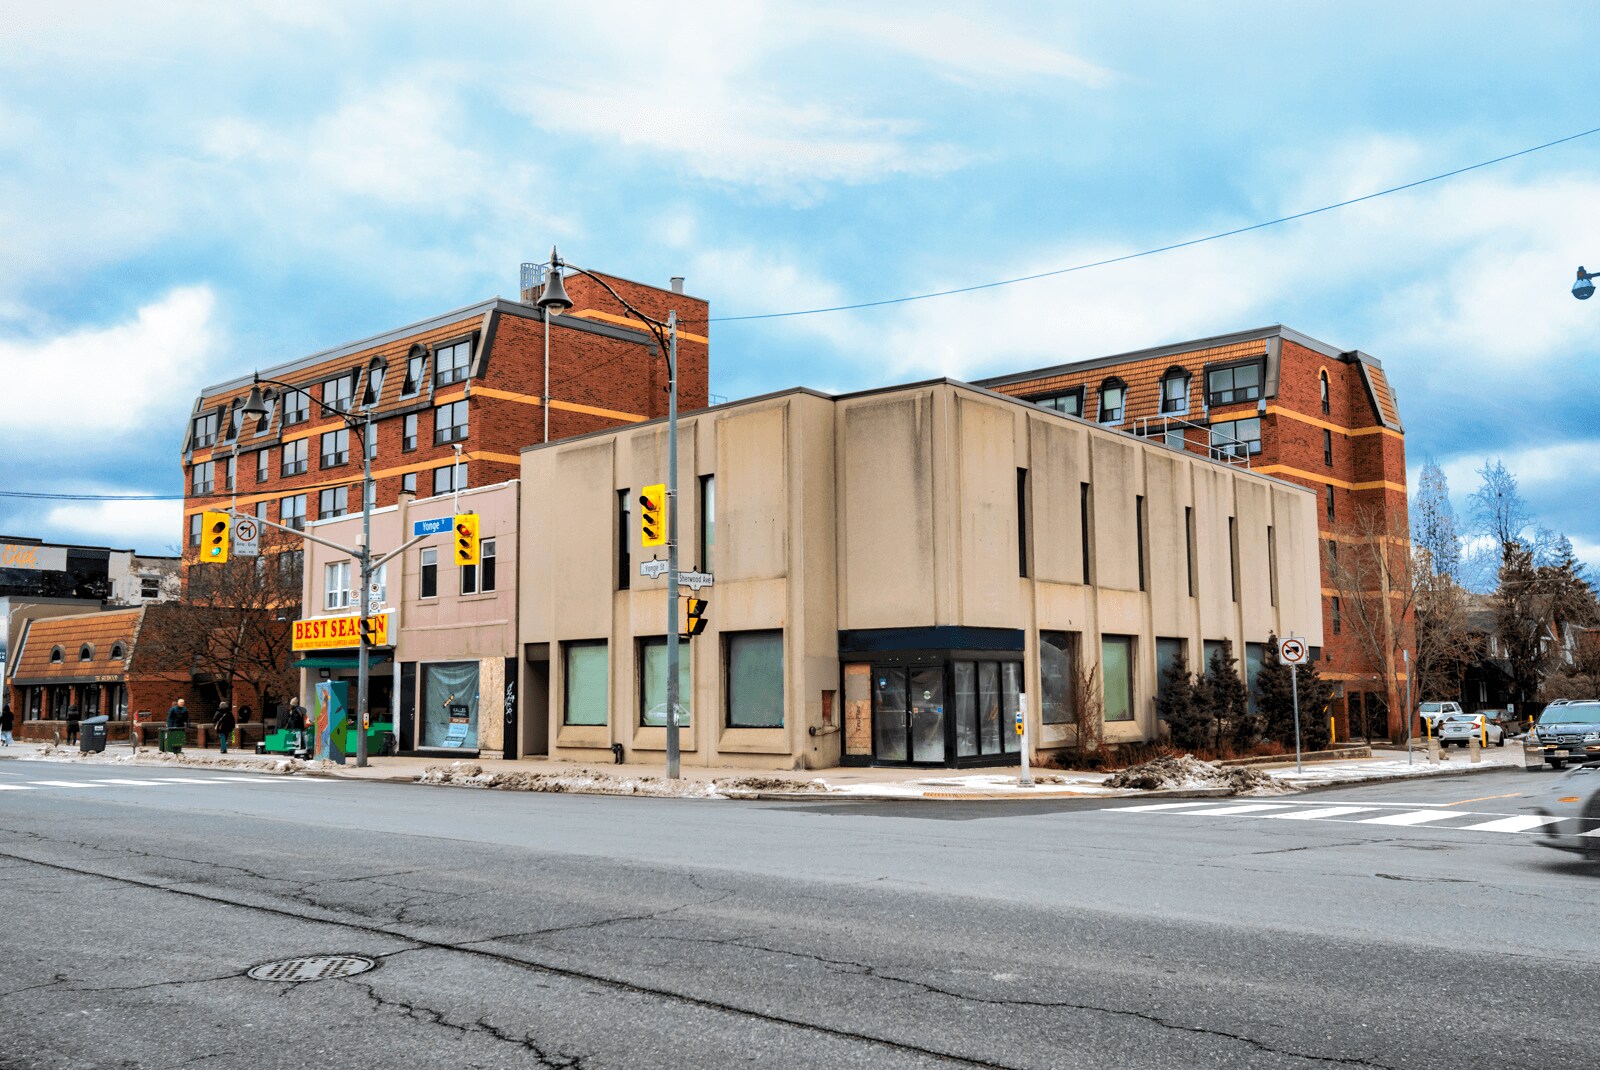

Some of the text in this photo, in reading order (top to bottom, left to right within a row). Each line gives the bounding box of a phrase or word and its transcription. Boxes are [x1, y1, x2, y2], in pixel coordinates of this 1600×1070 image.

[423, 521, 440, 533] Yonge
[645, 563, 665, 573] Yonge St
[679, 574, 711, 584] Sherwood Ave
[296, 615, 385, 640] BEST SEASN
